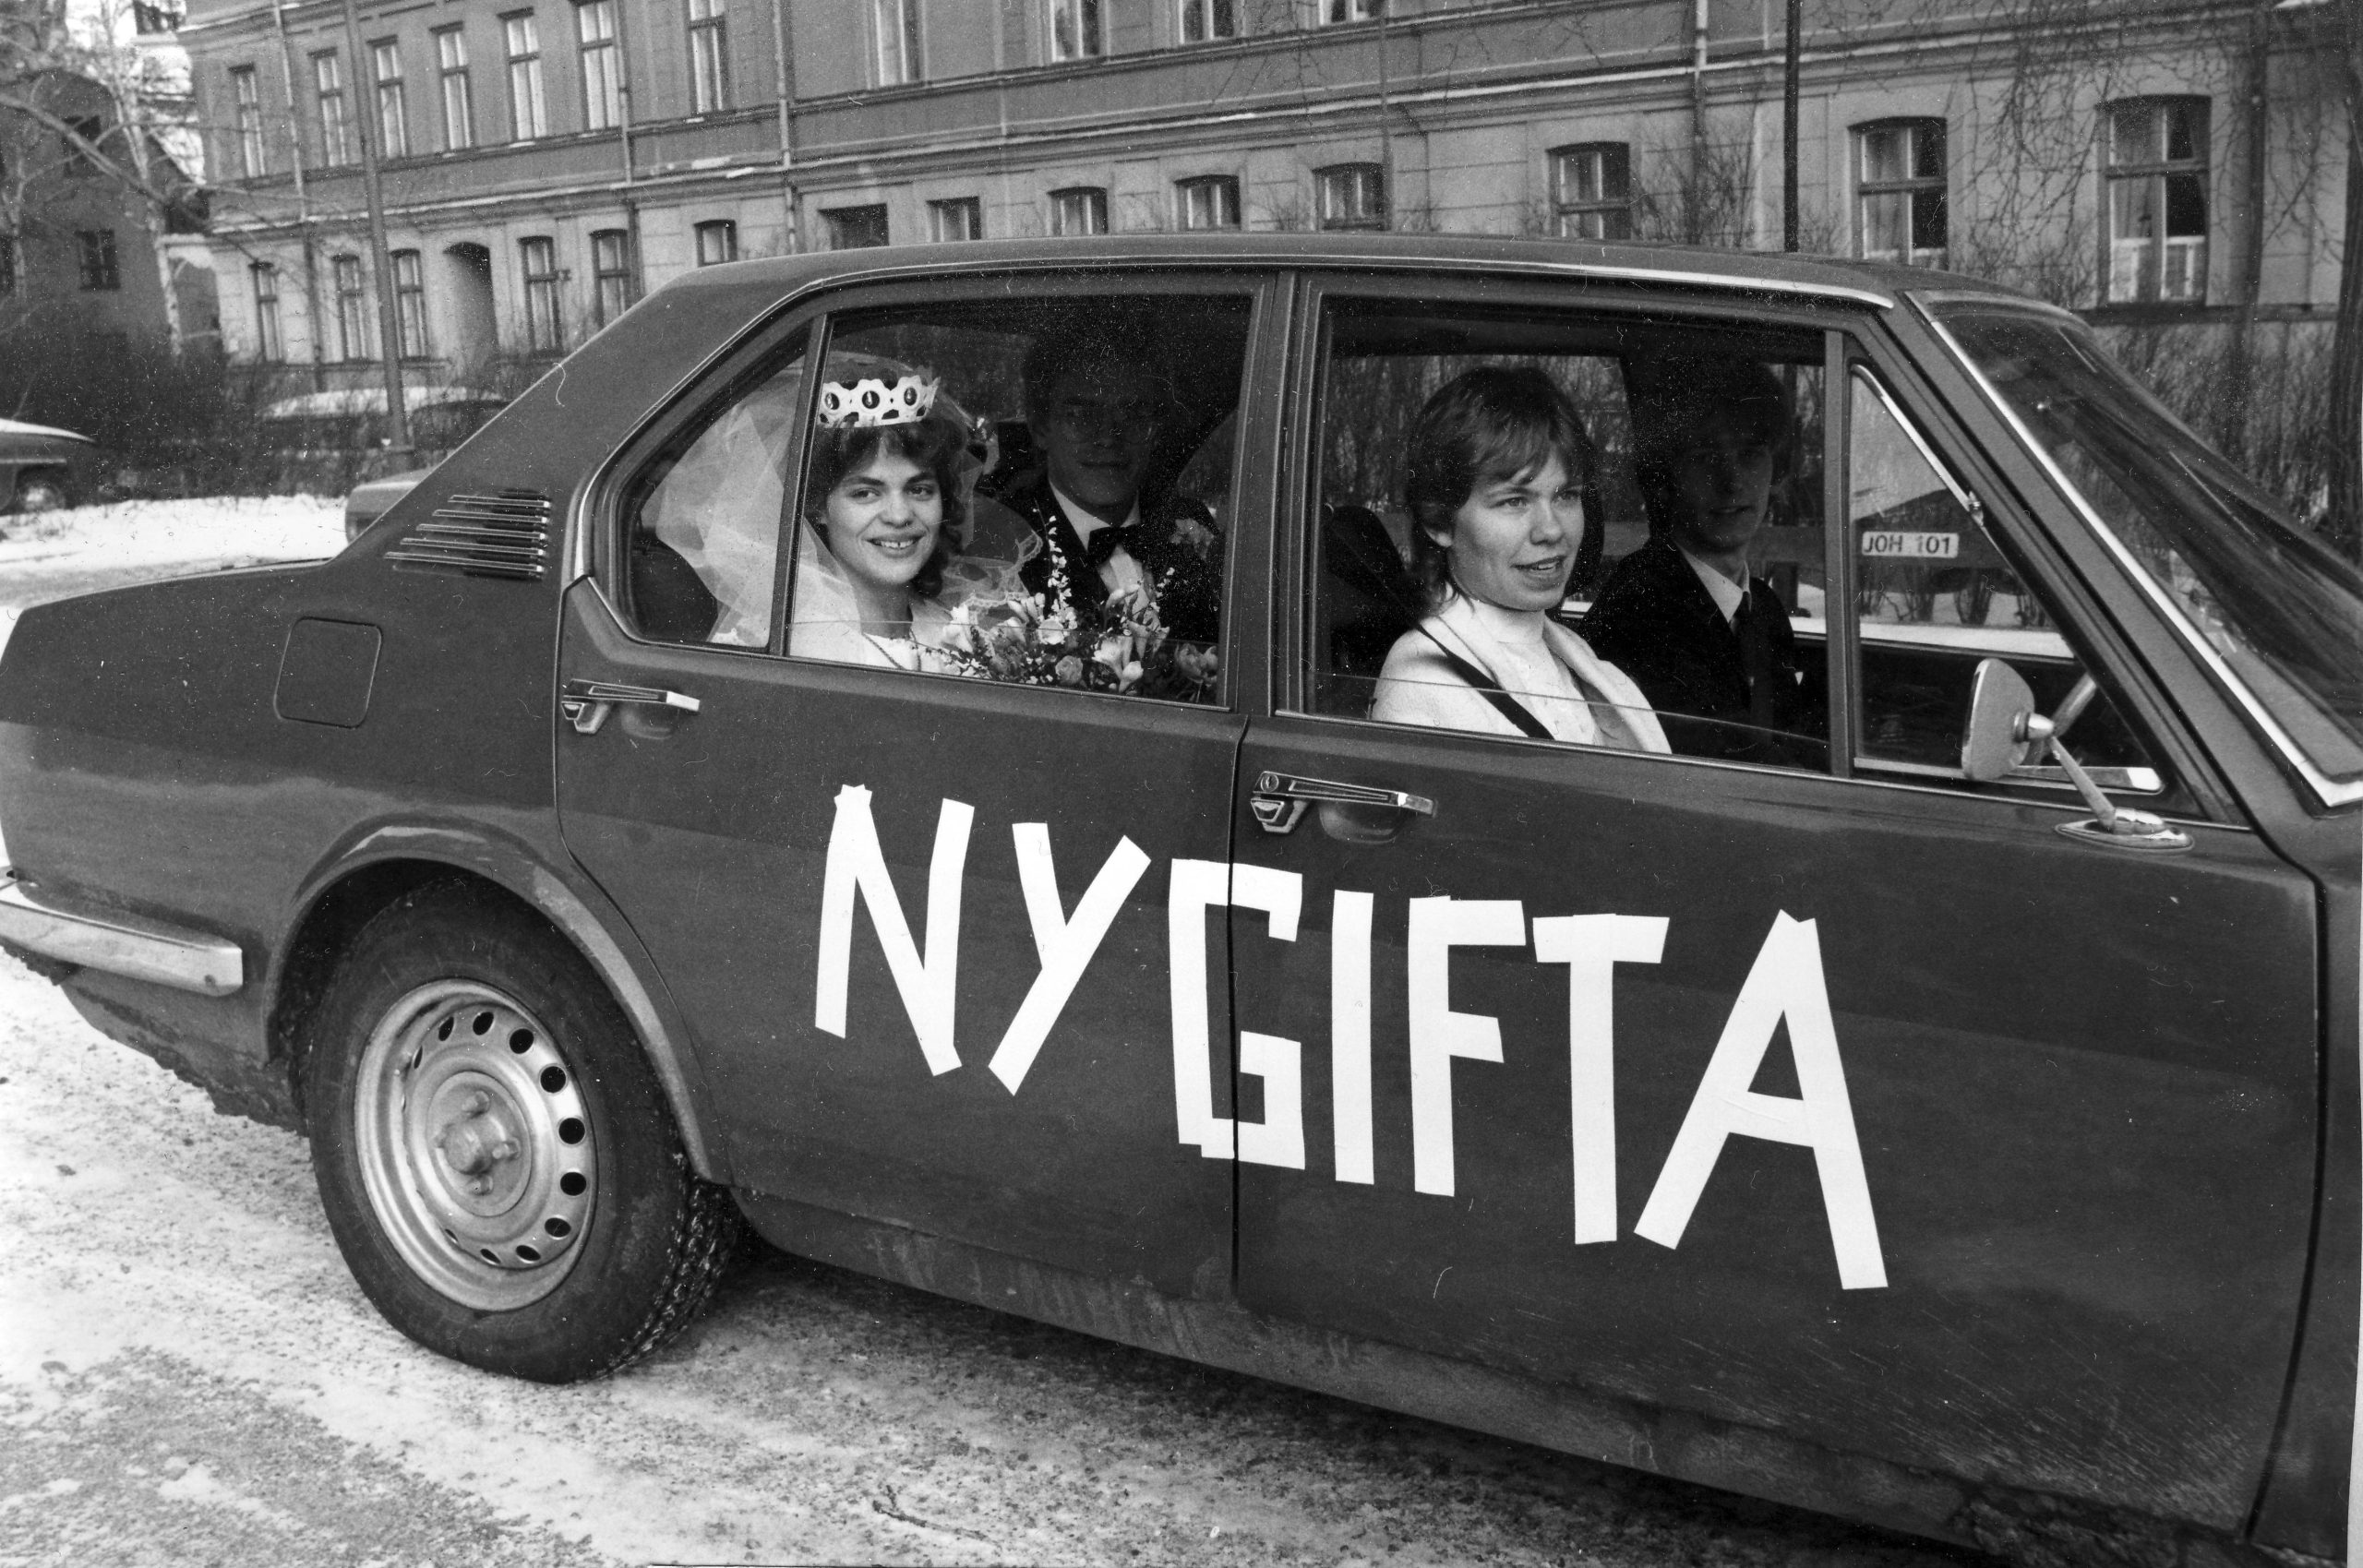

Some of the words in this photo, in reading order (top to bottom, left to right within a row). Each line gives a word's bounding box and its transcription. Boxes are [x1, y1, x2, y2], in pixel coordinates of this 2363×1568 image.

[1864, 534, 1903, 553] JOH
[1915, 535, 1950, 554] 101
[815, 783, 1888, 1290] NYGIFTA
